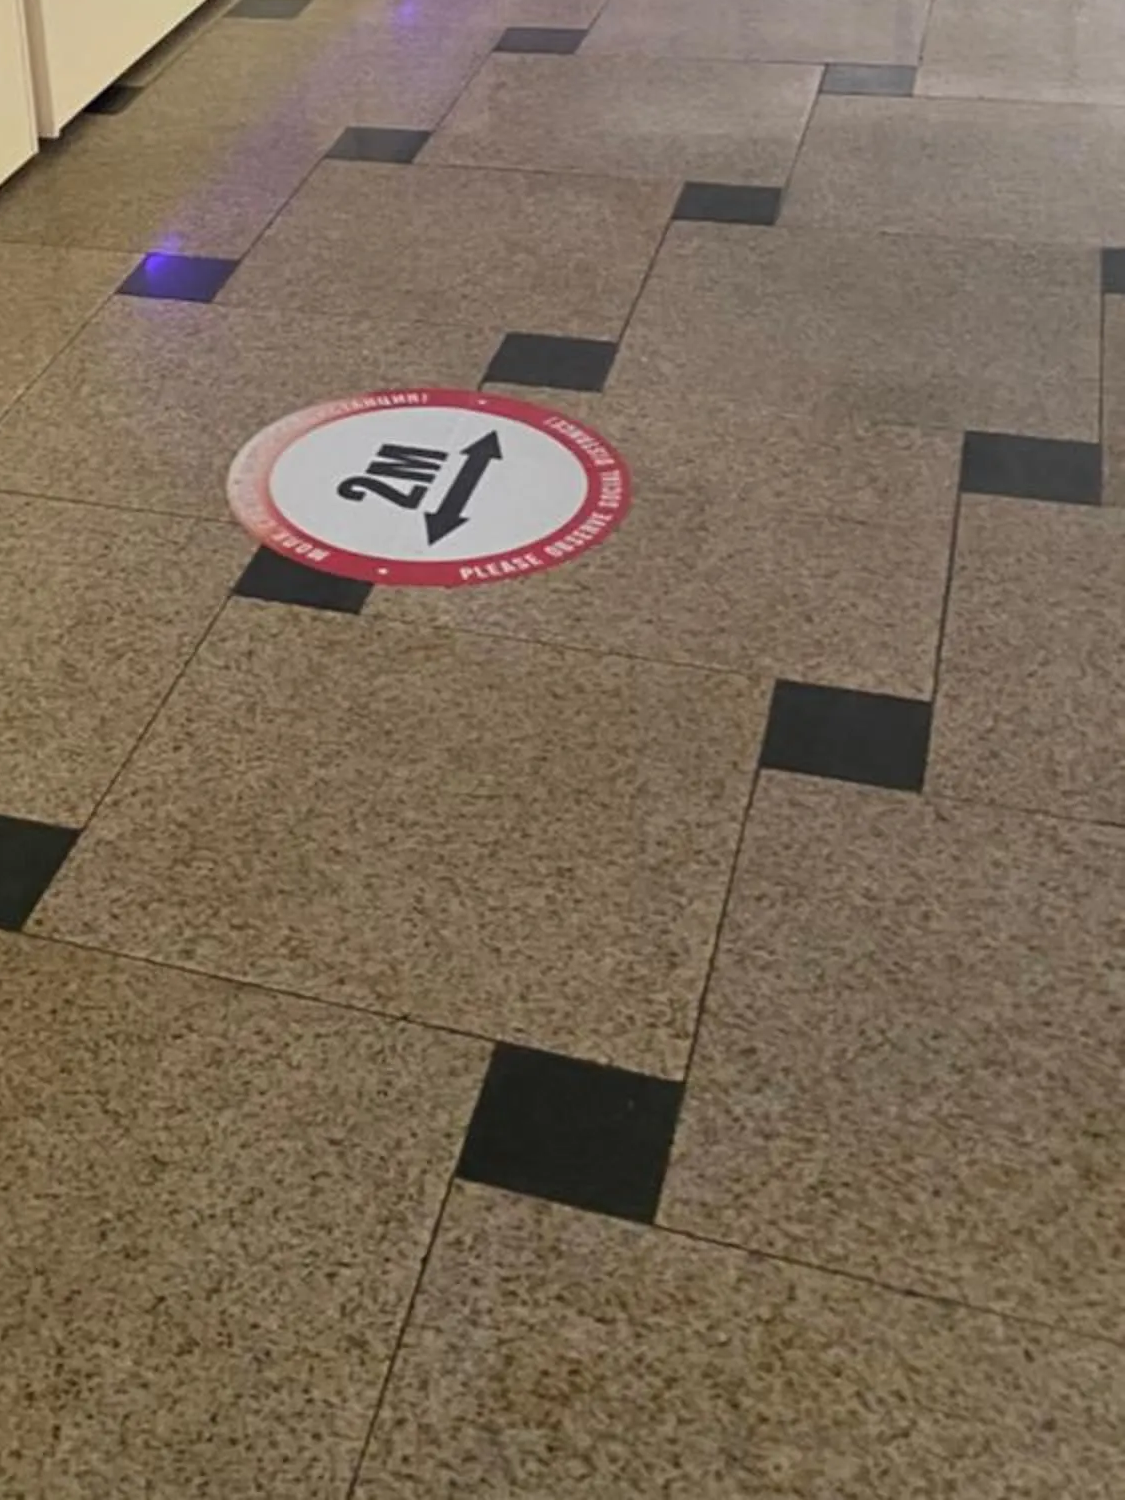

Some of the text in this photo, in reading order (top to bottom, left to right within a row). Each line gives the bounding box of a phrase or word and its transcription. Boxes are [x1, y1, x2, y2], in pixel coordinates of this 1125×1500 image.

[336, 443, 449, 510] 2M
[459, 552, 544, 581] PLEASE
[543, 511, 614, 558] OBSERVE
[599, 468, 623, 509] SOCIAL
